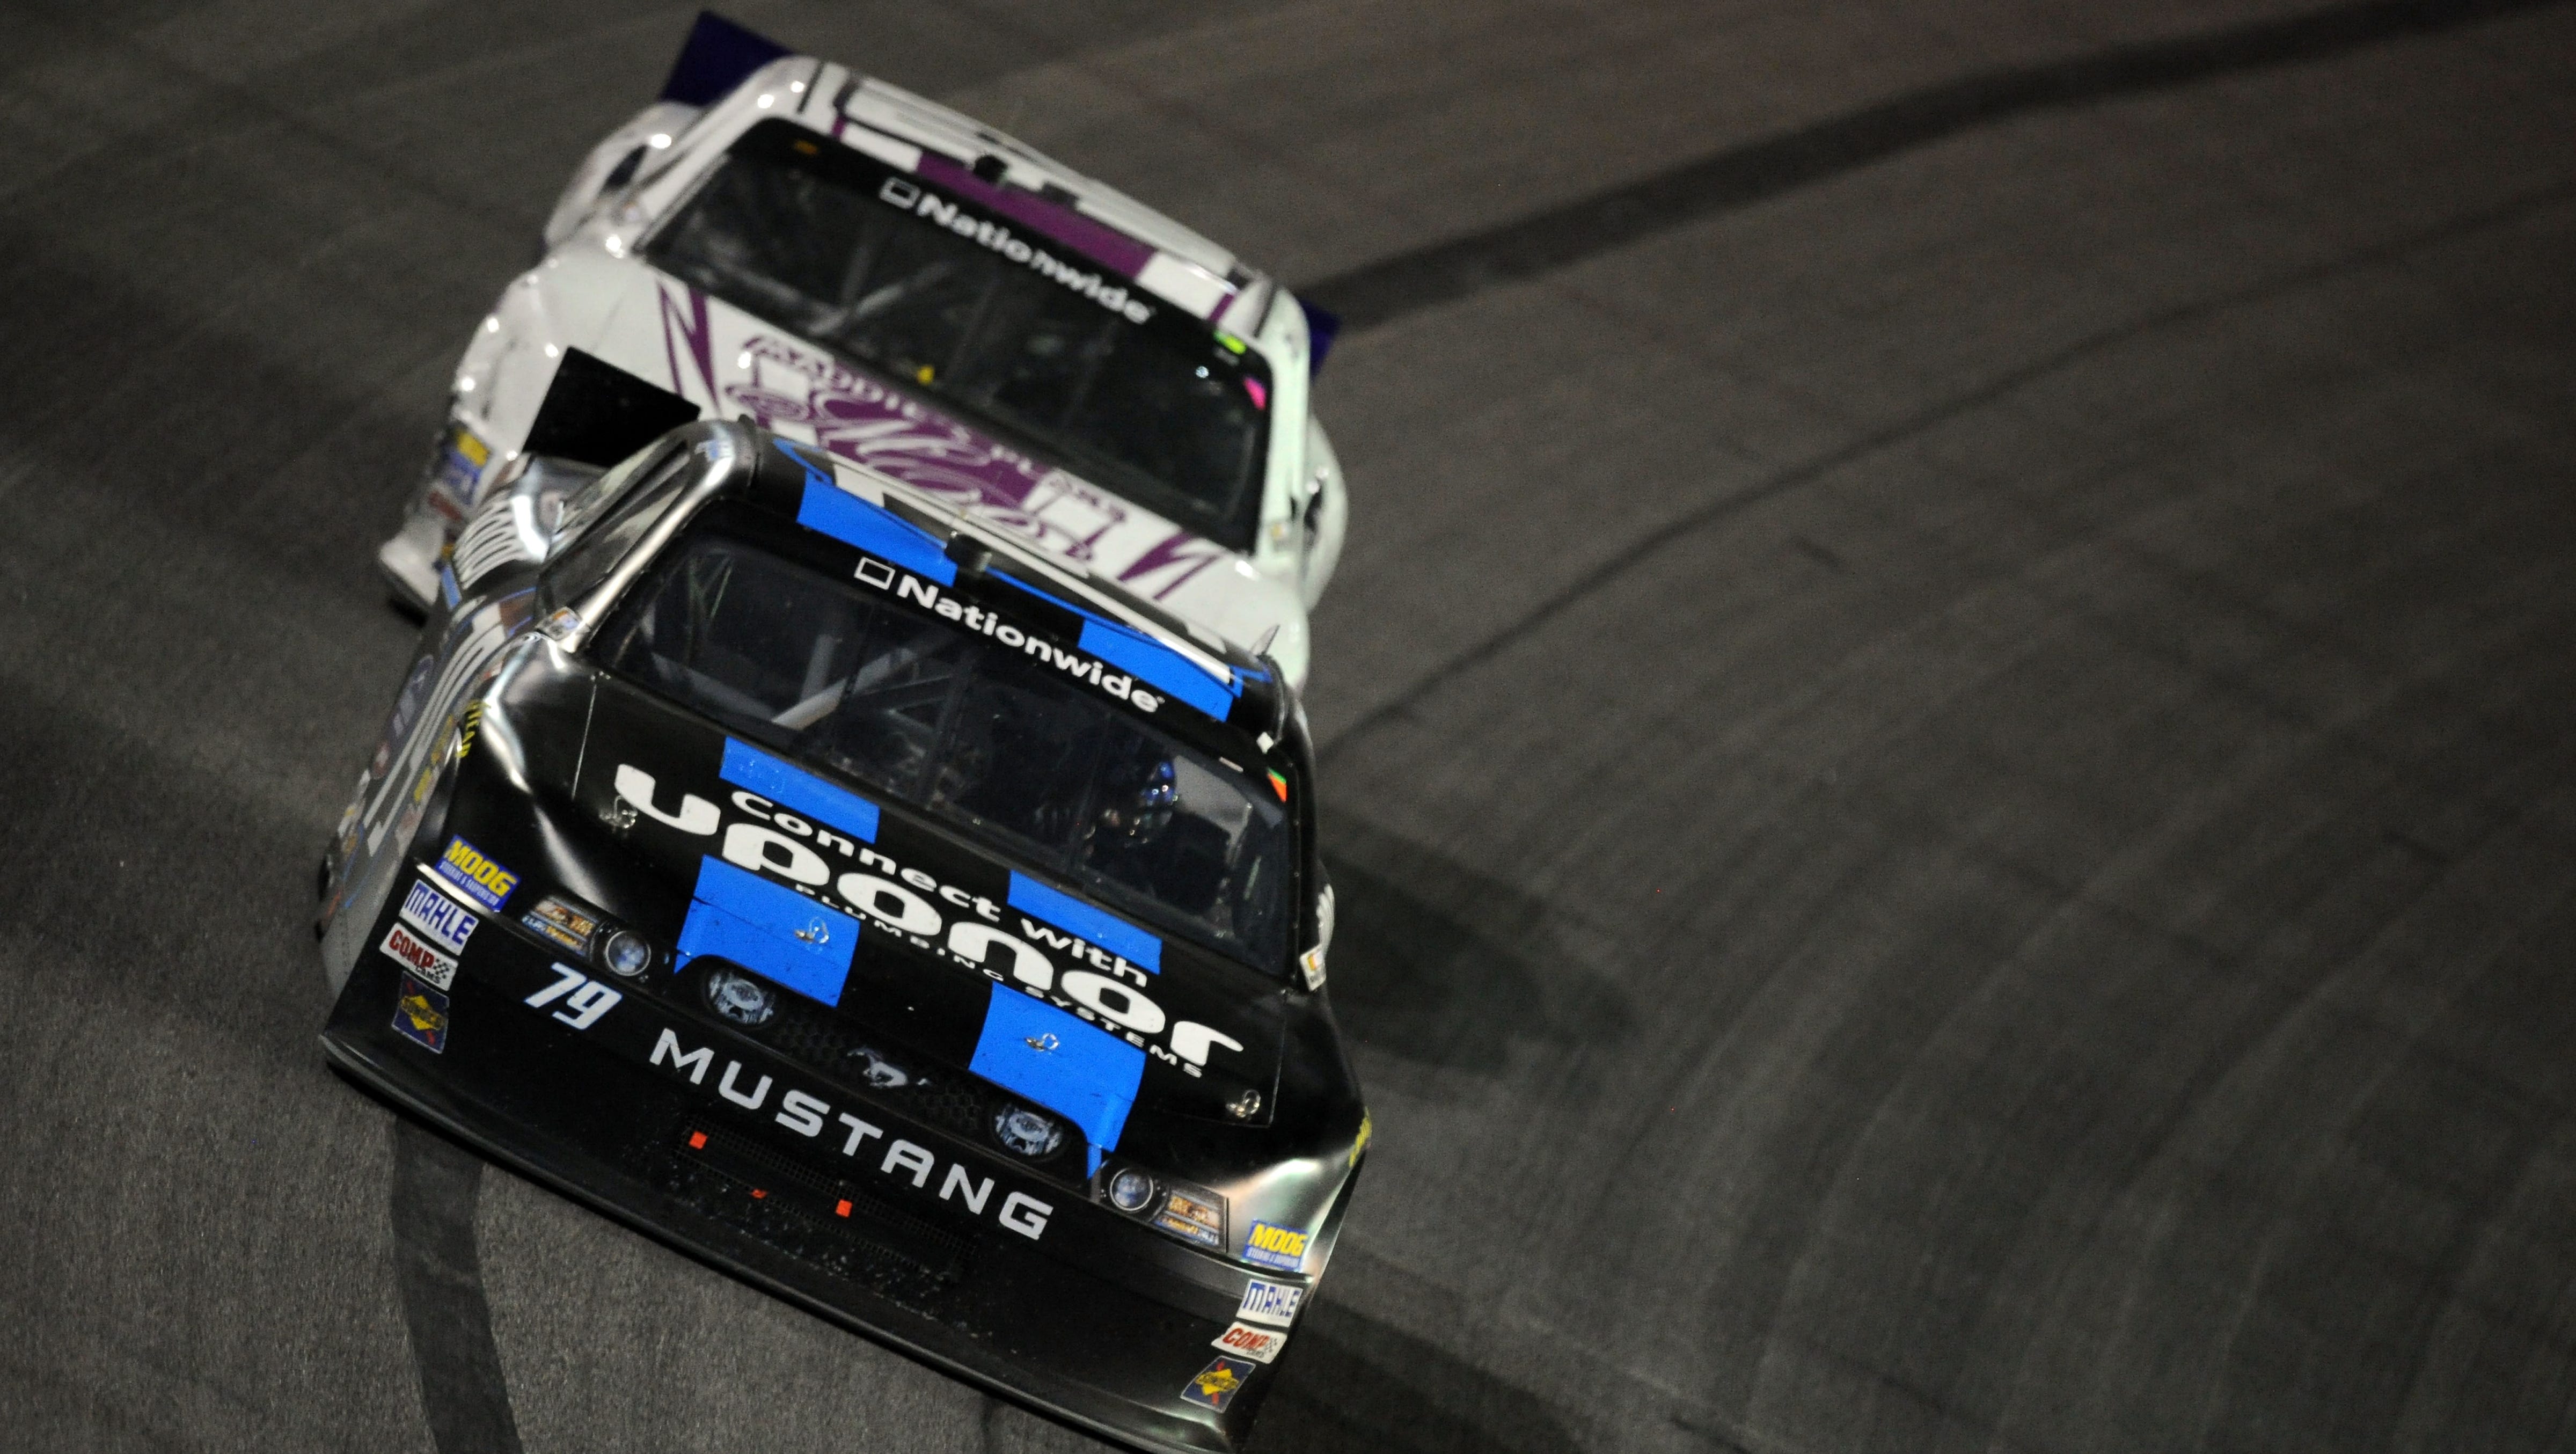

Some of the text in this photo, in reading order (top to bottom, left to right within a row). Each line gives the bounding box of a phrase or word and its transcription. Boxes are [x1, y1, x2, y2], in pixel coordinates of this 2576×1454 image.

[917, 193, 1152, 325] Nationwide
[897, 574, 1160, 714] Nationwide
[444, 839, 517, 897] MOOG
[730, 790, 1148, 987] Connect with
[405, 882, 475, 945] MAHLE
[614, 763, 1243, 1066] uponor
[389, 930, 435, 968] COMP
[795, 883, 1202, 1078] PLUMBING SYSTEMS
[524, 961, 623, 1031] 79
[649, 1027, 1053, 1241] MUSTANG
[1248, 1223, 1308, 1257] MOOG
[1243, 1282, 1300, 1317] MAHLE
[1223, 1328, 1270, 1350] COMP
